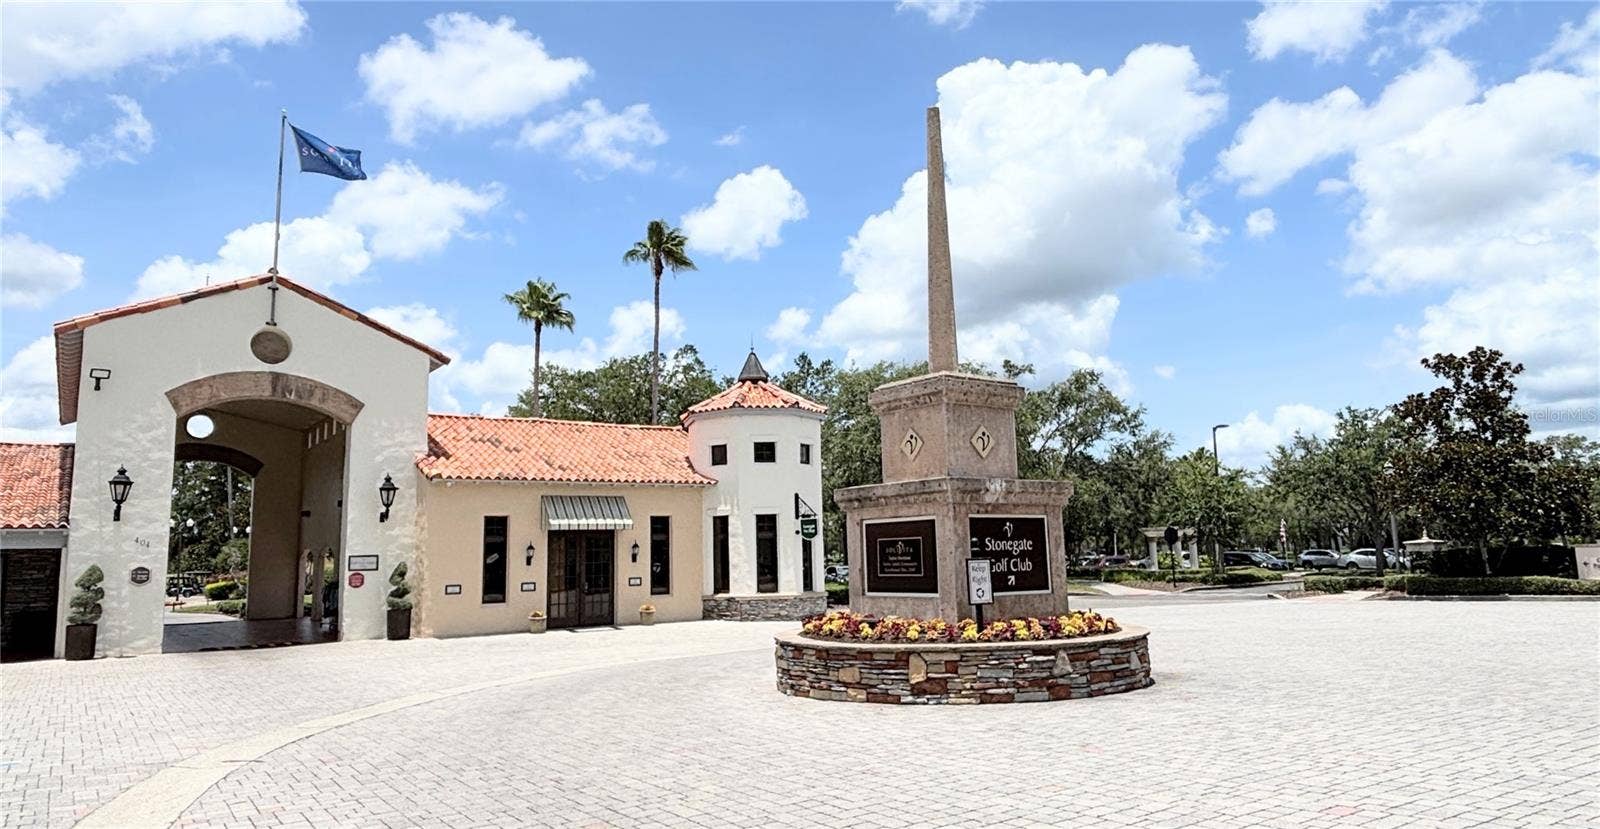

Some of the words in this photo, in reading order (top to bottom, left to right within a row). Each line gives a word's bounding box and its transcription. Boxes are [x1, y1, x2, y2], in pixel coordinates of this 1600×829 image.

[985, 537, 1033, 555] Stonegate
[971, 565, 986, 574] Keep
[1010, 557, 1032, 572] Club
